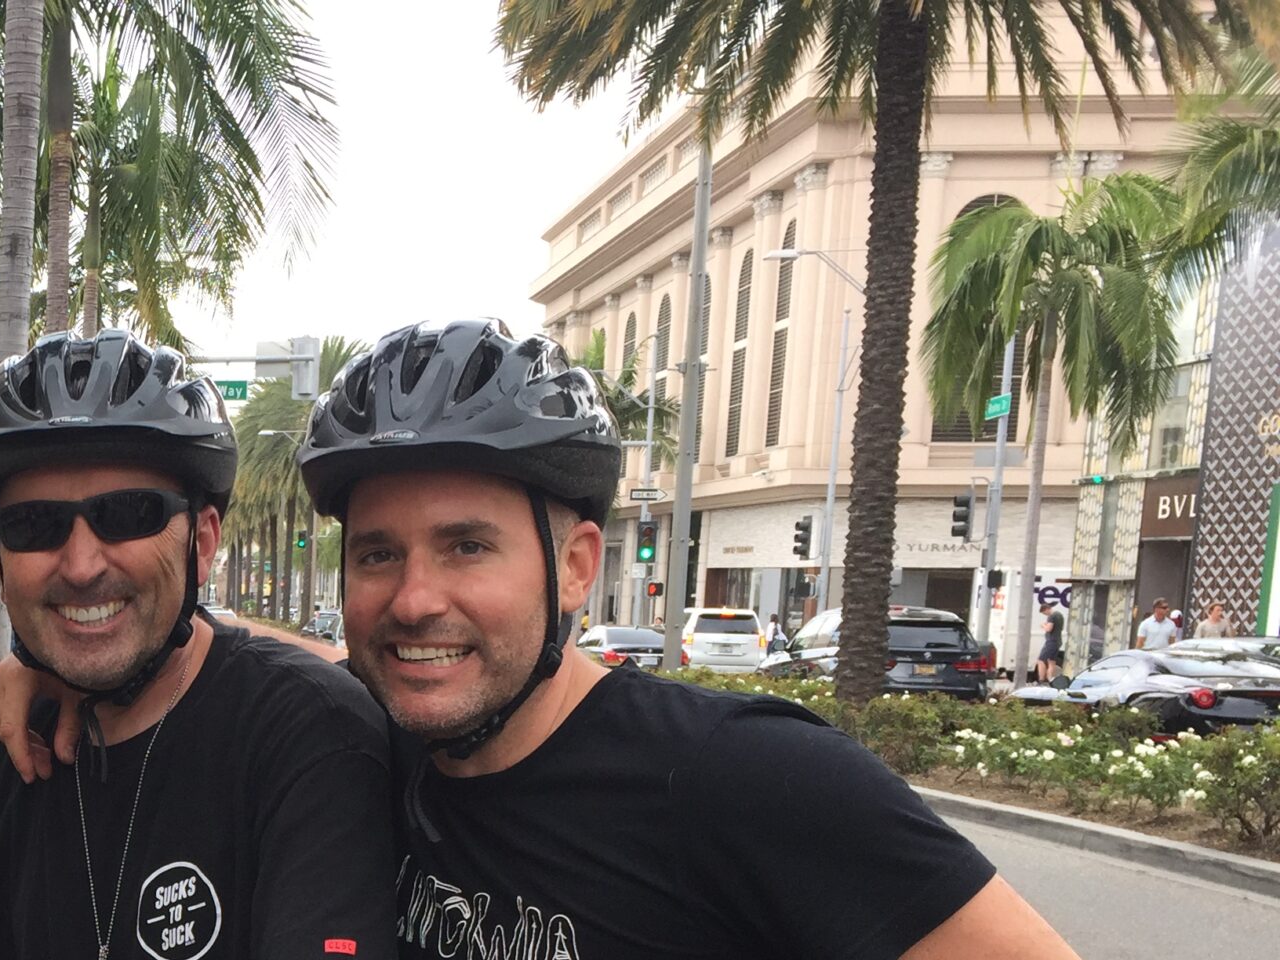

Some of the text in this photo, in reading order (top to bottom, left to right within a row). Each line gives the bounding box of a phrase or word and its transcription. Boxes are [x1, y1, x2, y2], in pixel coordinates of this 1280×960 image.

[218, 385, 243, 399] Way
[906, 543, 982, 553] YURMAN
[154, 876, 196, 910] SUCKS
[169, 904, 183, 925] TO
[161, 920, 195, 951] SUCK
